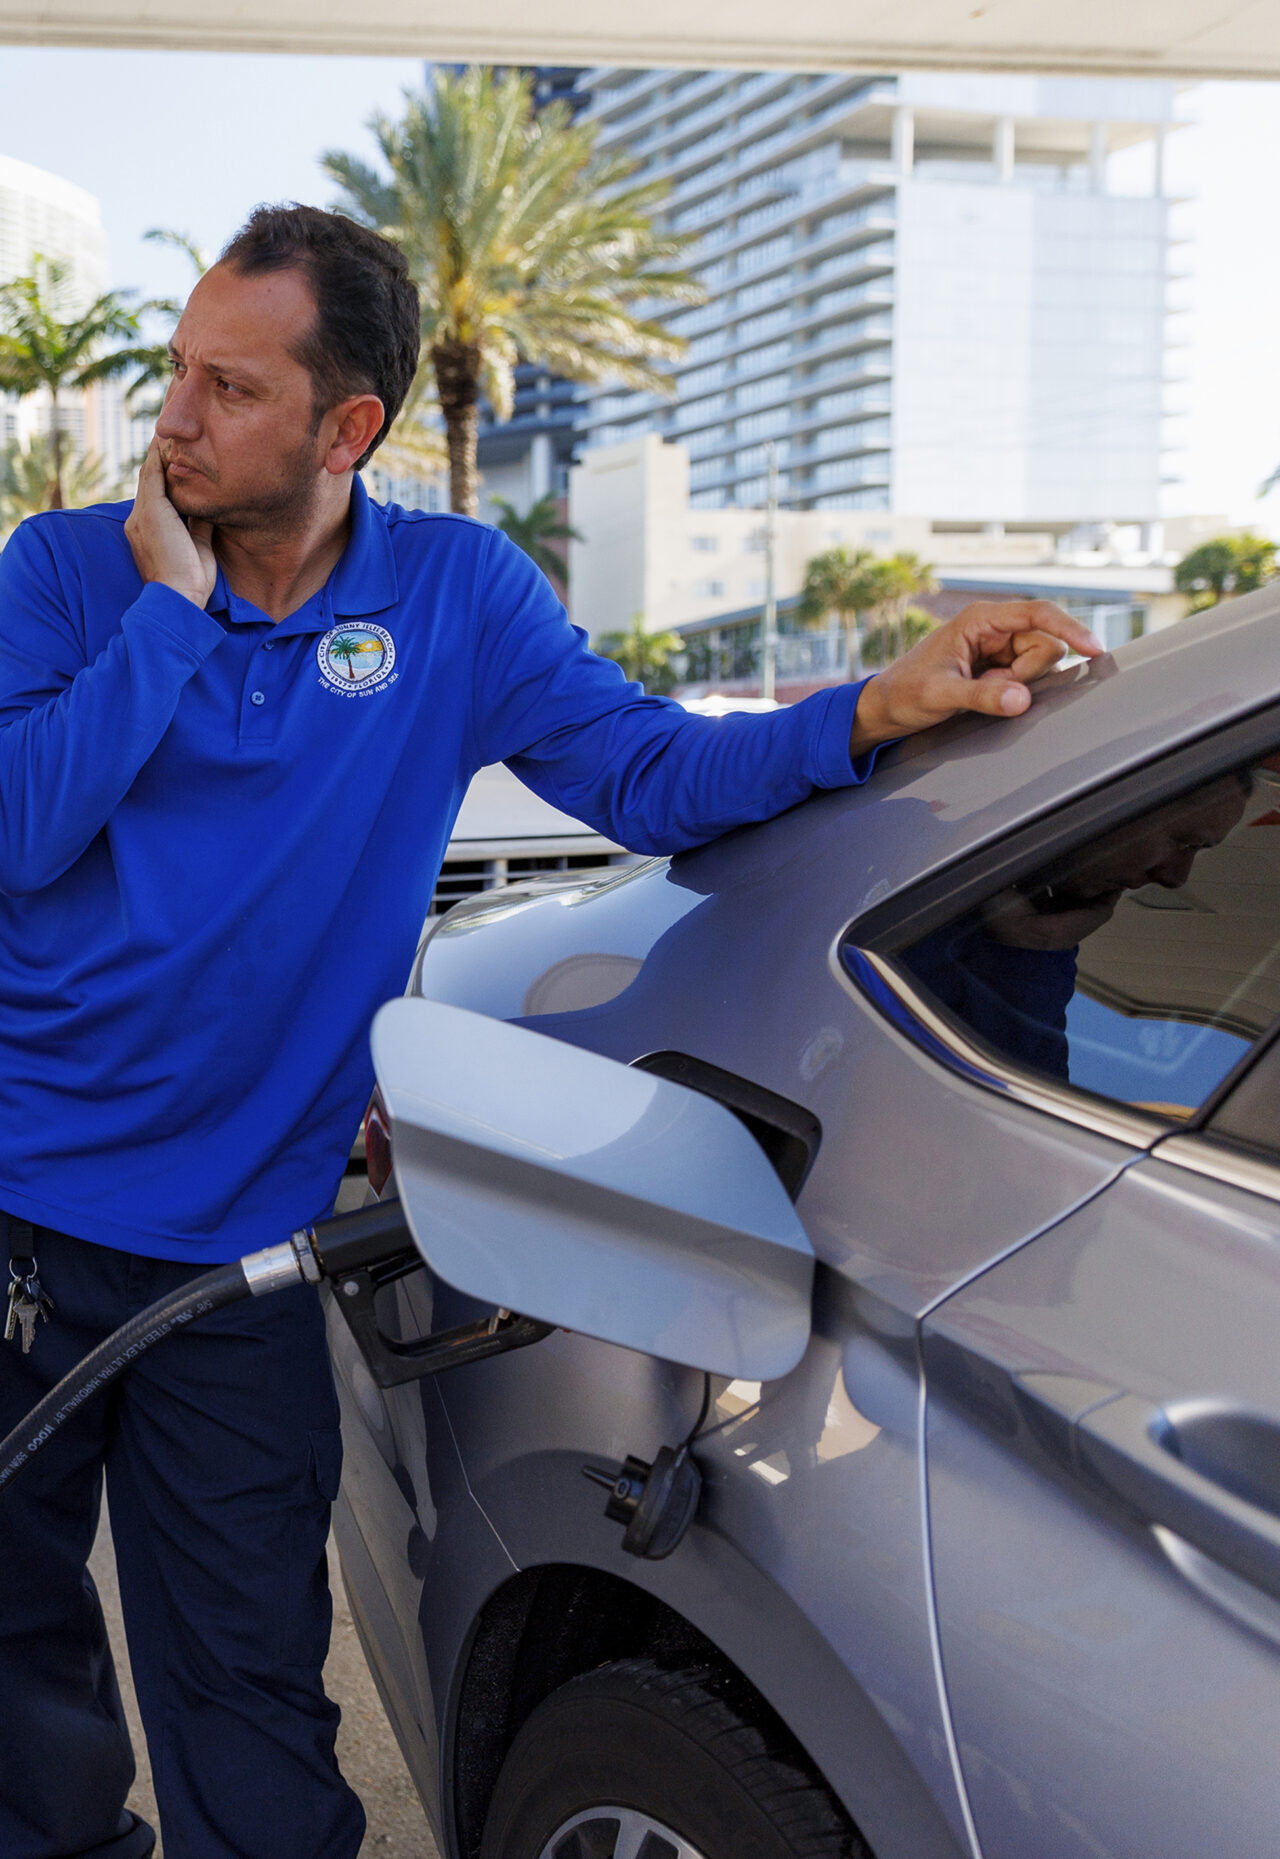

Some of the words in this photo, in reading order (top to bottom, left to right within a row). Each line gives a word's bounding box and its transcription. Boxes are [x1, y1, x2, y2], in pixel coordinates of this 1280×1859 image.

[319, 641, 327, 657] CITY
[334, 623, 360, 632] SUNNY
[362, 624, 380, 633] ISLES
[380, 629, 394, 653] BEACH
[318, 676, 329, 689] THE
[330, 687, 345, 697] CITY
[359, 689, 374, 698] SUN
[375, 683, 388, 693] AND
[388, 672, 400, 685] SEA
[354, 669, 388, 689] FLORIDA
[124, 1323, 172, 1360] STEELFLEX
[98, 1357, 125, 1380] ULTRA
[54, 1412, 65, 1424] BY
